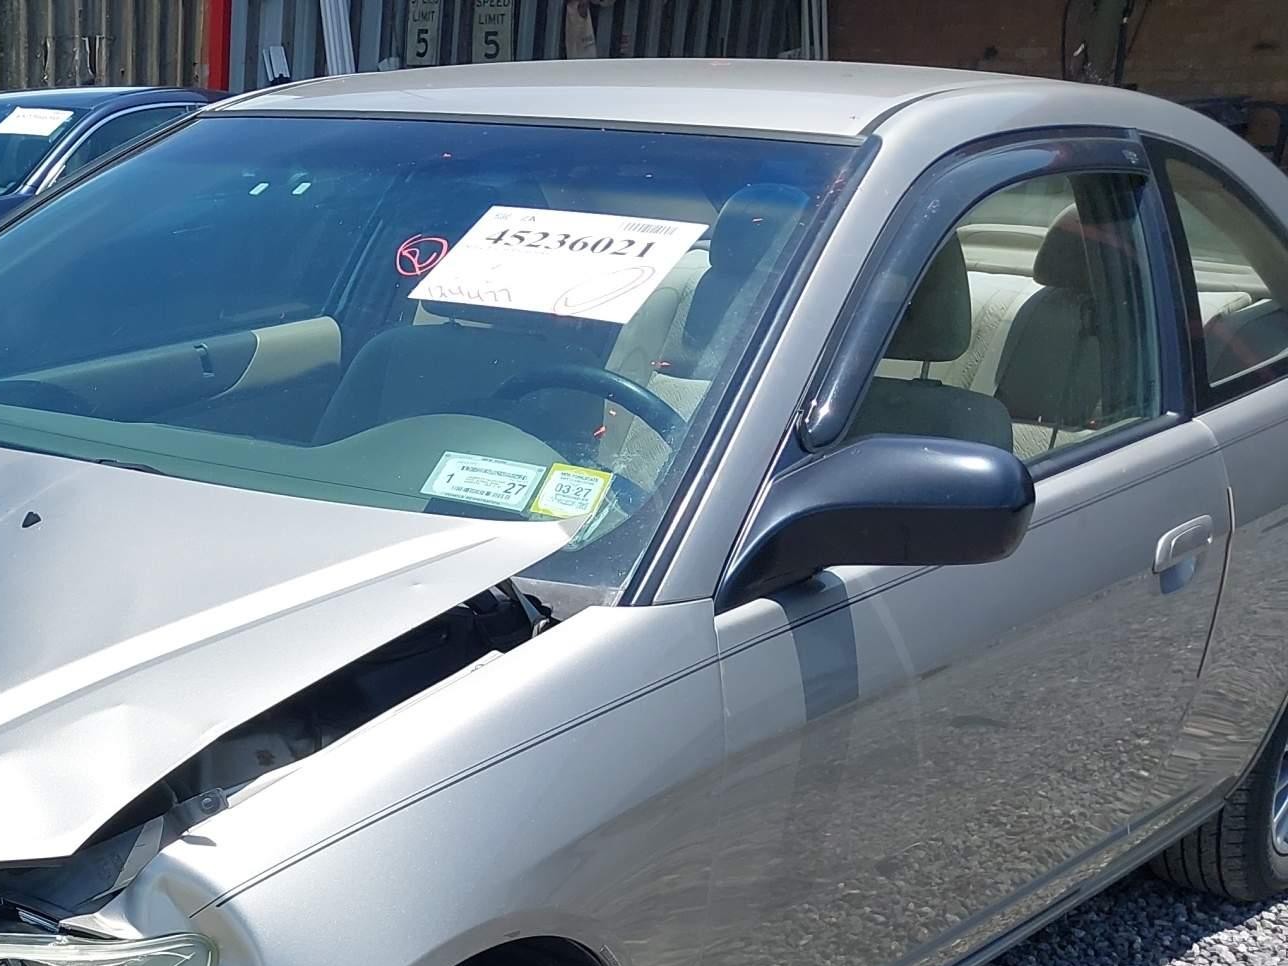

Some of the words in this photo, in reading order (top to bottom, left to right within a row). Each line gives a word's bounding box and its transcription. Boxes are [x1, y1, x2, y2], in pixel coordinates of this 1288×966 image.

[478, 13, 505, 25] LIMIT
[415, 28, 429, 58] 5
[483, 30, 500, 59] 5
[485, 229, 657, 258] 45236021
[503, 482, 527, 496] 27
